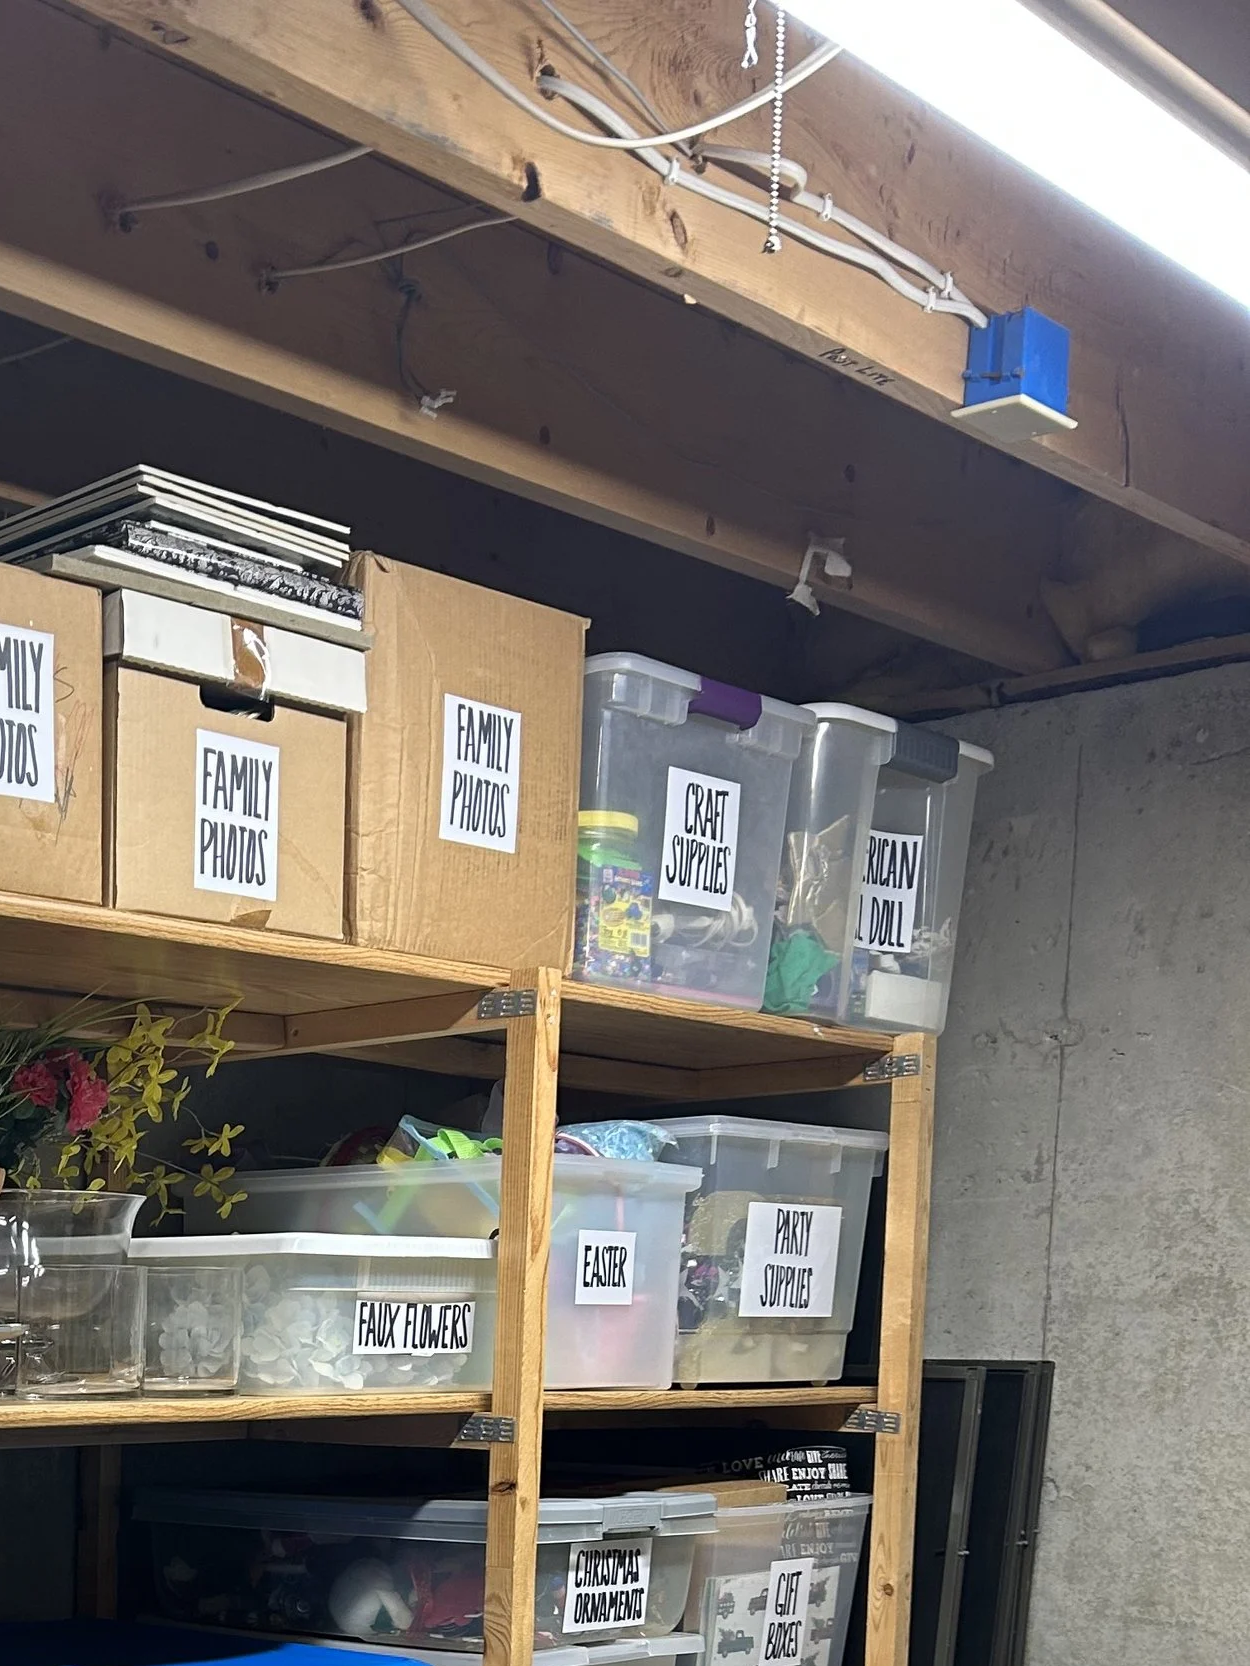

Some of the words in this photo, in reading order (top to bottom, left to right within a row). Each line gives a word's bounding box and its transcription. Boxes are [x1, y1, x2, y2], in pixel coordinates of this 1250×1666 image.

[456, 704, 514, 774] FAMILY
[202, 747, 272, 822] FAMILY
[452, 771, 509, 838] PHOTOS
[685, 782, 729, 835] CRAFT
[199, 819, 268, 886] PHOTOS
[666, 835, 731, 896] SUPPLIES
[864, 836, 918, 890] RICAN
[869, 897, 904, 948] DOLL
[774, 1208, 813, 1257] PARTY
[583, 1245, 627, 1288] EASTER
[760, 1263, 813, 1309] SUPPLIES
[358, 1302, 400, 1348] FAUX
[403, 1303, 471, 1349] FLOWERS
[791, 1467, 826, 1481] ENJOY
[575, 1548, 641, 1588] CHRISTMAS
[574, 1587, 644, 1625] ORNAMENTS
[775, 1571, 803, 1616] GIFT
[765, 1621, 801, 1661] BOXES
